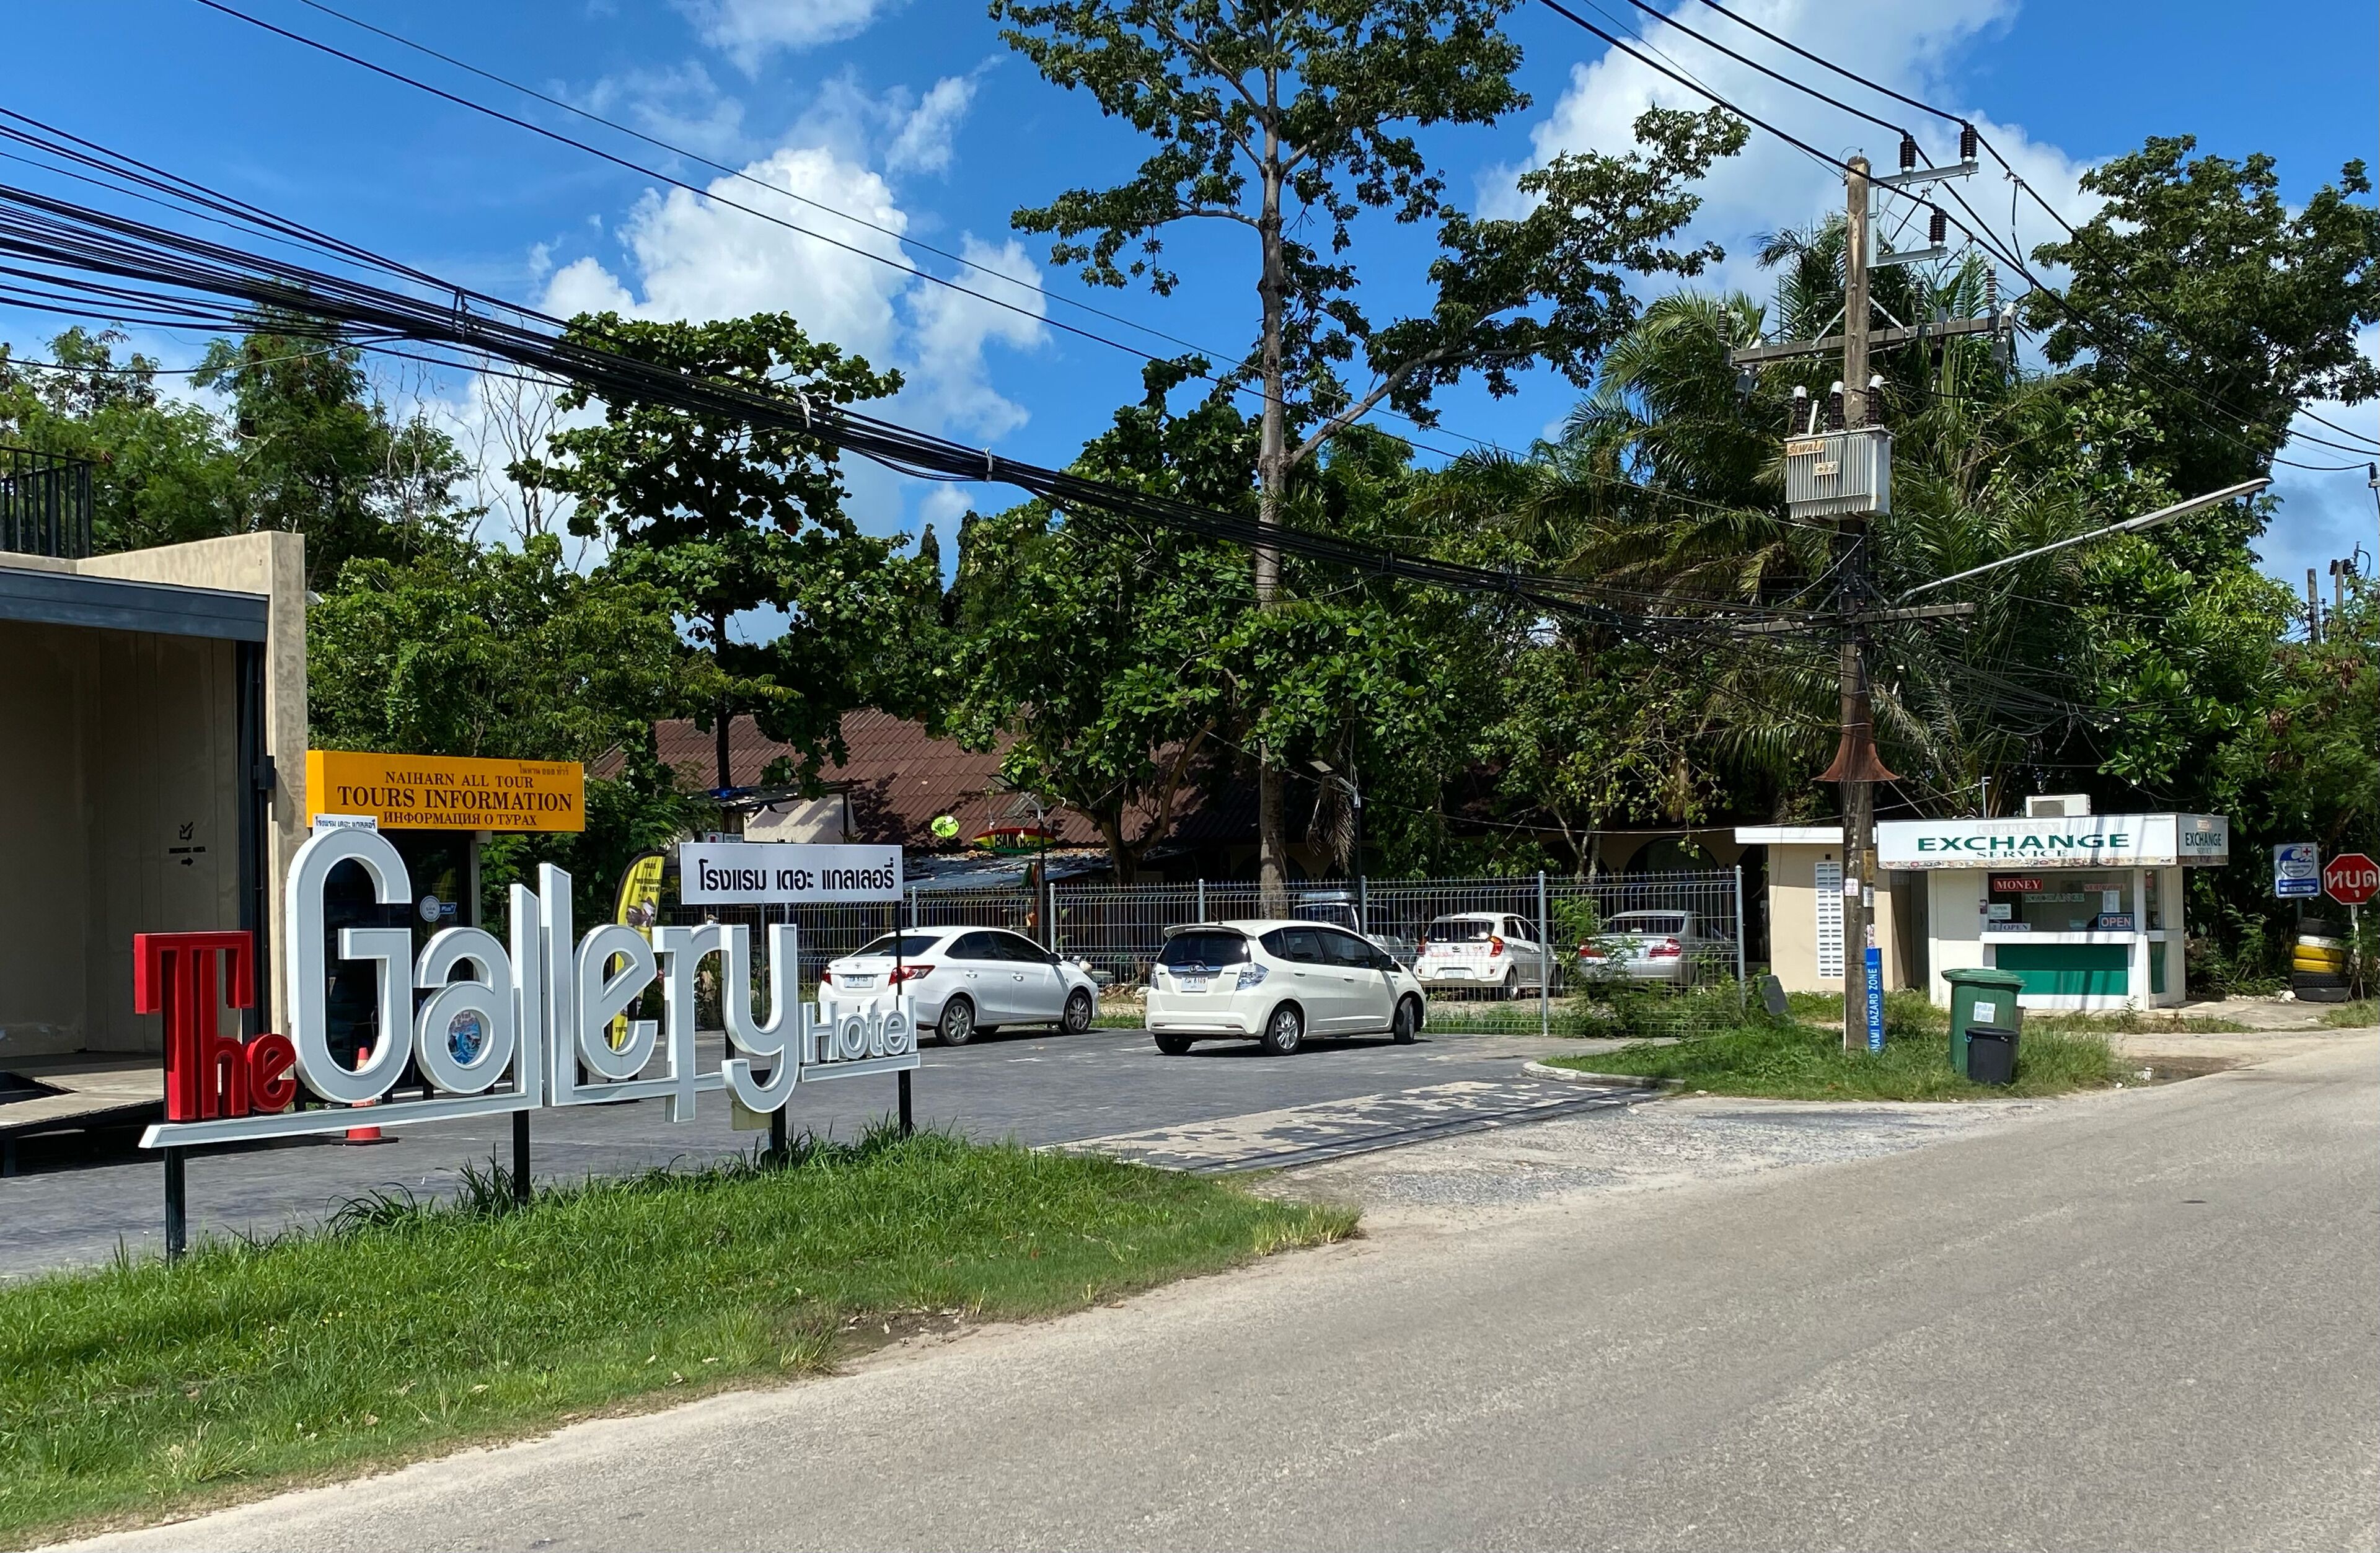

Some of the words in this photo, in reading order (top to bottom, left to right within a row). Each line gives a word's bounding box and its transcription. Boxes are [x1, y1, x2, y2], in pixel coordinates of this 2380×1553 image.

[385, 772, 454, 786] NAIHARN
[461, 775, 489, 787] ALL
[495, 776, 534, 788] TOUR
[337, 786, 415, 807] TOURS
[425, 789, 572, 812] INFORMATION
[383, 811, 481, 826] ИНФОРМАЦИЯ
[496, 814, 537, 826] ТУРАХ
[1977, 823, 2058, 834] CURRENCY
[1918, 834, 2130, 851] EXCHANGE
[2185, 832, 2222, 847] EXCHANGE
[1976, 849, 2068, 858] SERVICE
[699, 858, 767, 891] โรงแรม
[777, 869, 814, 891] เดอะ
[822, 856, 894, 890] แกลเลอรี่
[1996, 880, 2040, 889] MONEY
[2327, 870, 2378, 898] หยุด
[2100, 917, 2131, 927] OPEN
[134, 931, 296, 1121] The
[286, 827, 797, 1122] Gallery
[799, 995, 917, 1064] Hotel
[1868, 969, 1878, 990] ZONE
[1869, 993, 1879, 1026] HAZARD
